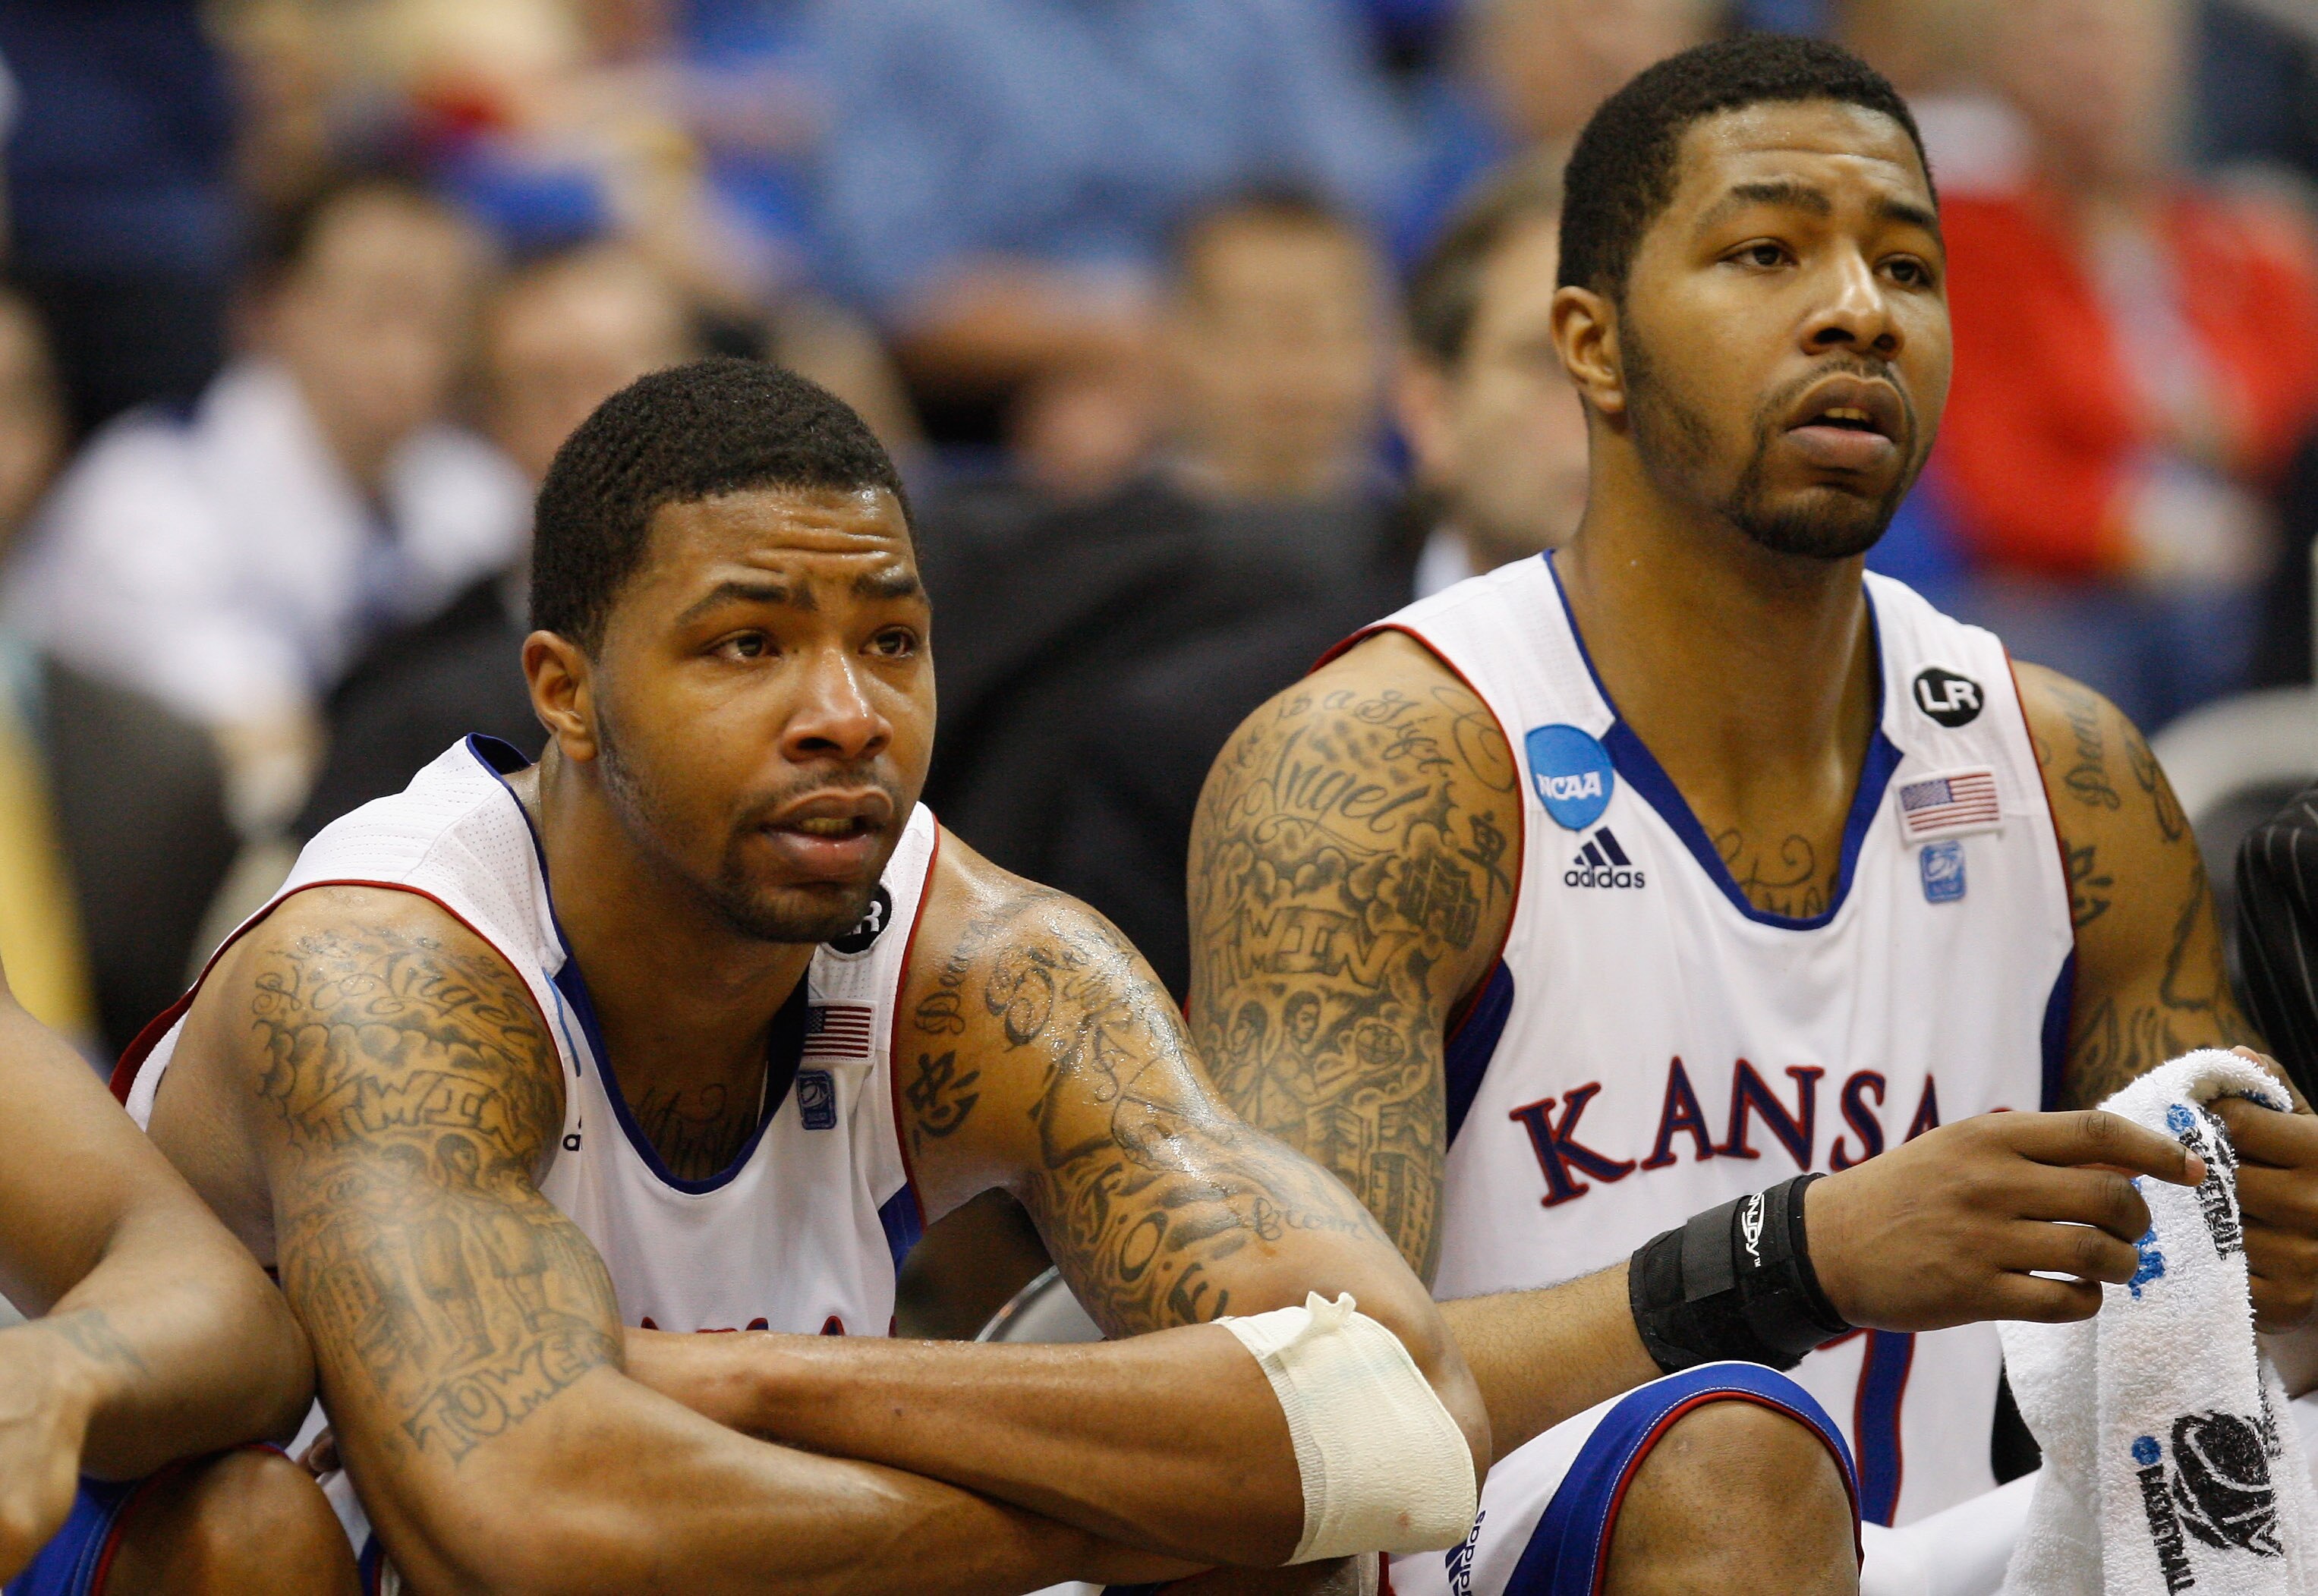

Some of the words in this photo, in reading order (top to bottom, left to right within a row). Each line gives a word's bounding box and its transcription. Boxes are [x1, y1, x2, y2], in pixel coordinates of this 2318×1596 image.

[1917, 678, 1980, 713] LR
[1535, 770, 1603, 801] NCAA
[1564, 866, 1646, 889] adidas
[1509, 1056, 2013, 1208] KANSA
